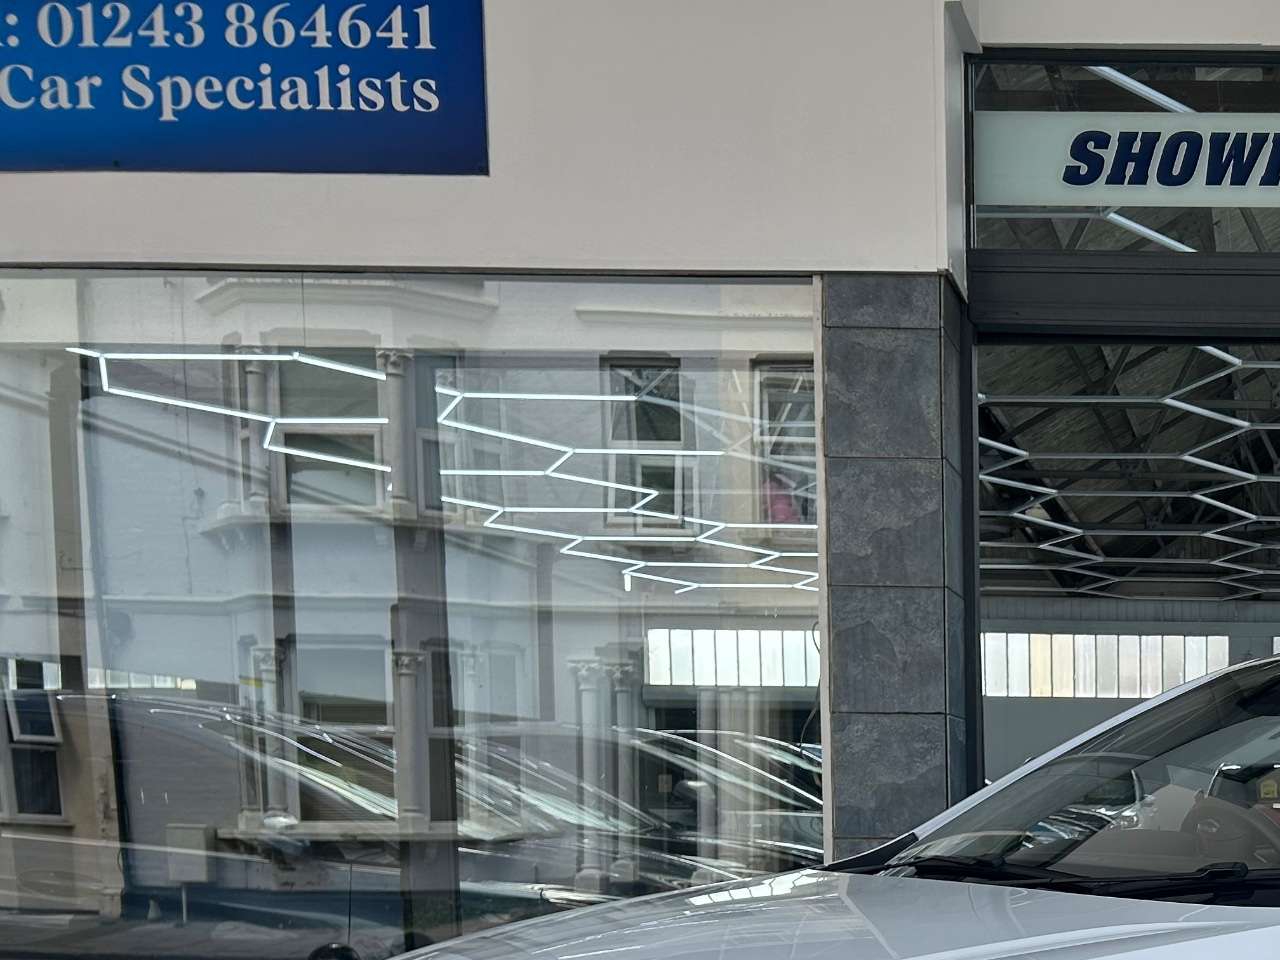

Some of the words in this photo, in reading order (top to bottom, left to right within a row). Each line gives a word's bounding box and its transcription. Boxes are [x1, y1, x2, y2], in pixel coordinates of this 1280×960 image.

[37, 2, 206, 48] 01243
[224, 3, 436, 50] 864641
[0, 64, 102, 110] Car
[121, 63, 440, 121] Specialists
